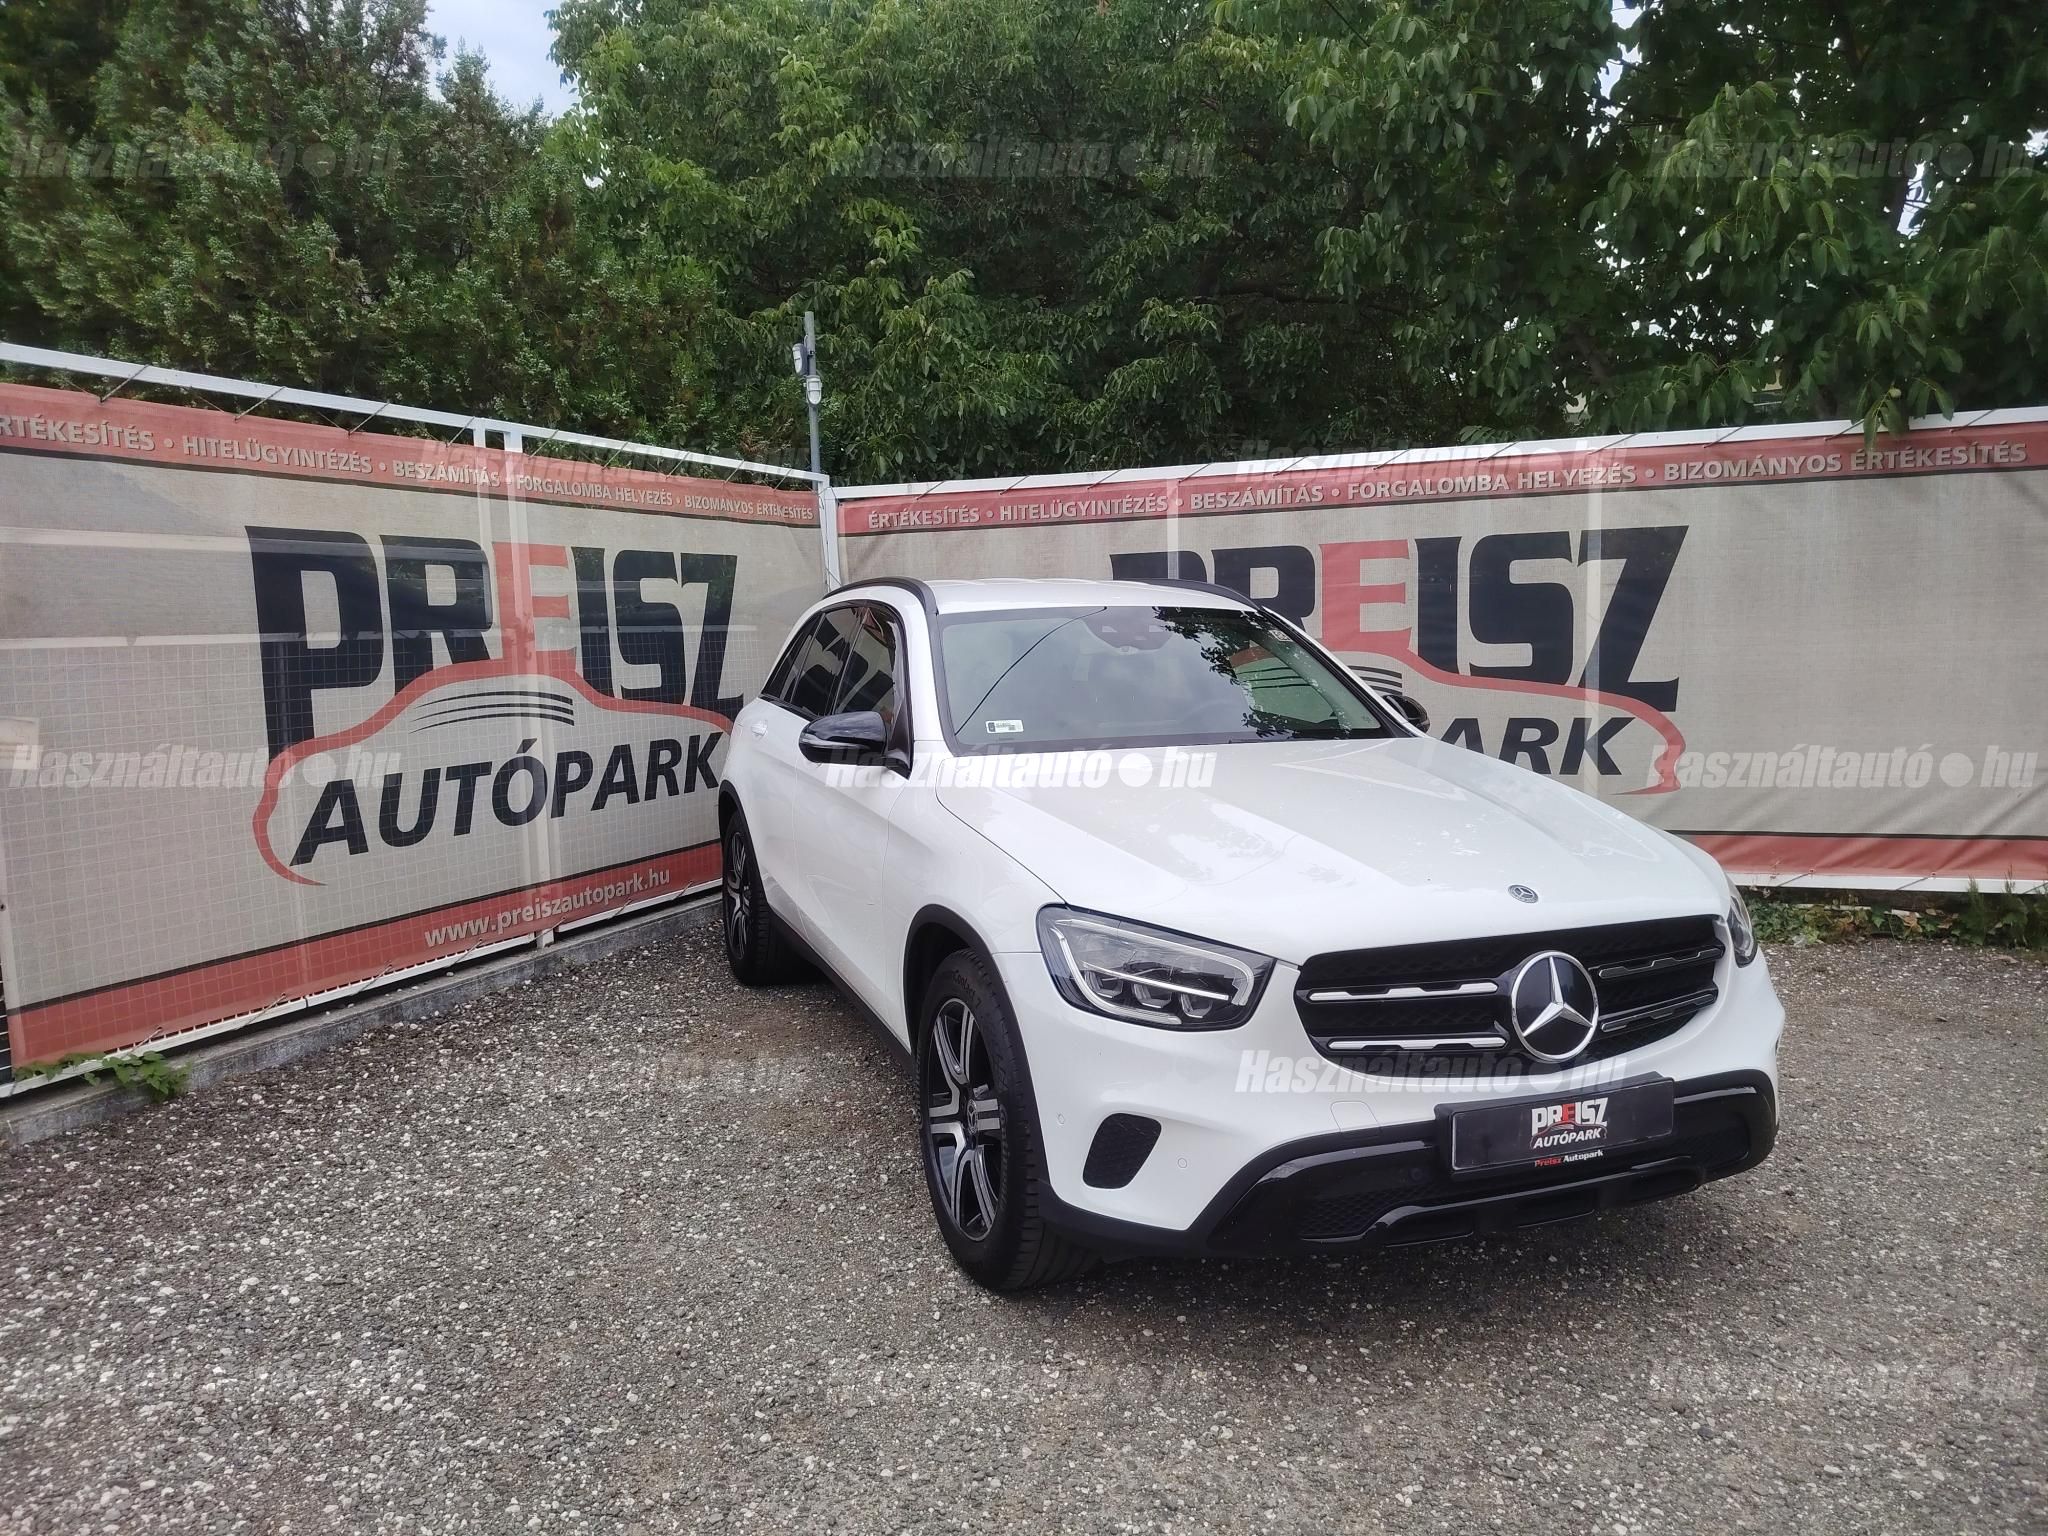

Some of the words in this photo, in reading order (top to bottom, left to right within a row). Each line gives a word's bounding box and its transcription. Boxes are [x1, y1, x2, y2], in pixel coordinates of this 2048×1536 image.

[0, 413, 156, 451] RTÉKESÍTÉS
[183, 436, 373, 474] HITELÜGYINTÉZÉS
[393, 459, 501, 487] BESZÁMÍTÁS
[516, 474, 611, 500] FORGALOMBA
[615, 487, 674, 506] HELYEZÉS
[868, 506, 981, 529] ÉRTÉKESÍTÉS
[999, 496, 1169, 522] HITELÜGYINTÉZÉS
[1190, 485, 1324, 510] BESZÁMÍTÁS
[1347, 473, 1510, 500] FORGALOMBA
[1517, 464, 1637, 489] HELYEZÉS
[1663, 452, 1842, 482] BIZOMÁNYOS
[1850, 441, 2029, 472] ÉRTÉKESÍTÉS
[245, 525, 745, 767] PREISZ
[289, 731, 724, 868] AUTÓPARK
[424, 868, 671, 948] www.preiszautopark.hu
[1531, 1097, 1609, 1136] PREISZ
[1533, 1126, 1602, 1149] AUTÓPARK
[1534, 1156, 1563, 1168] Preisz
[1563, 1149, 1604, 1164] Autopark
